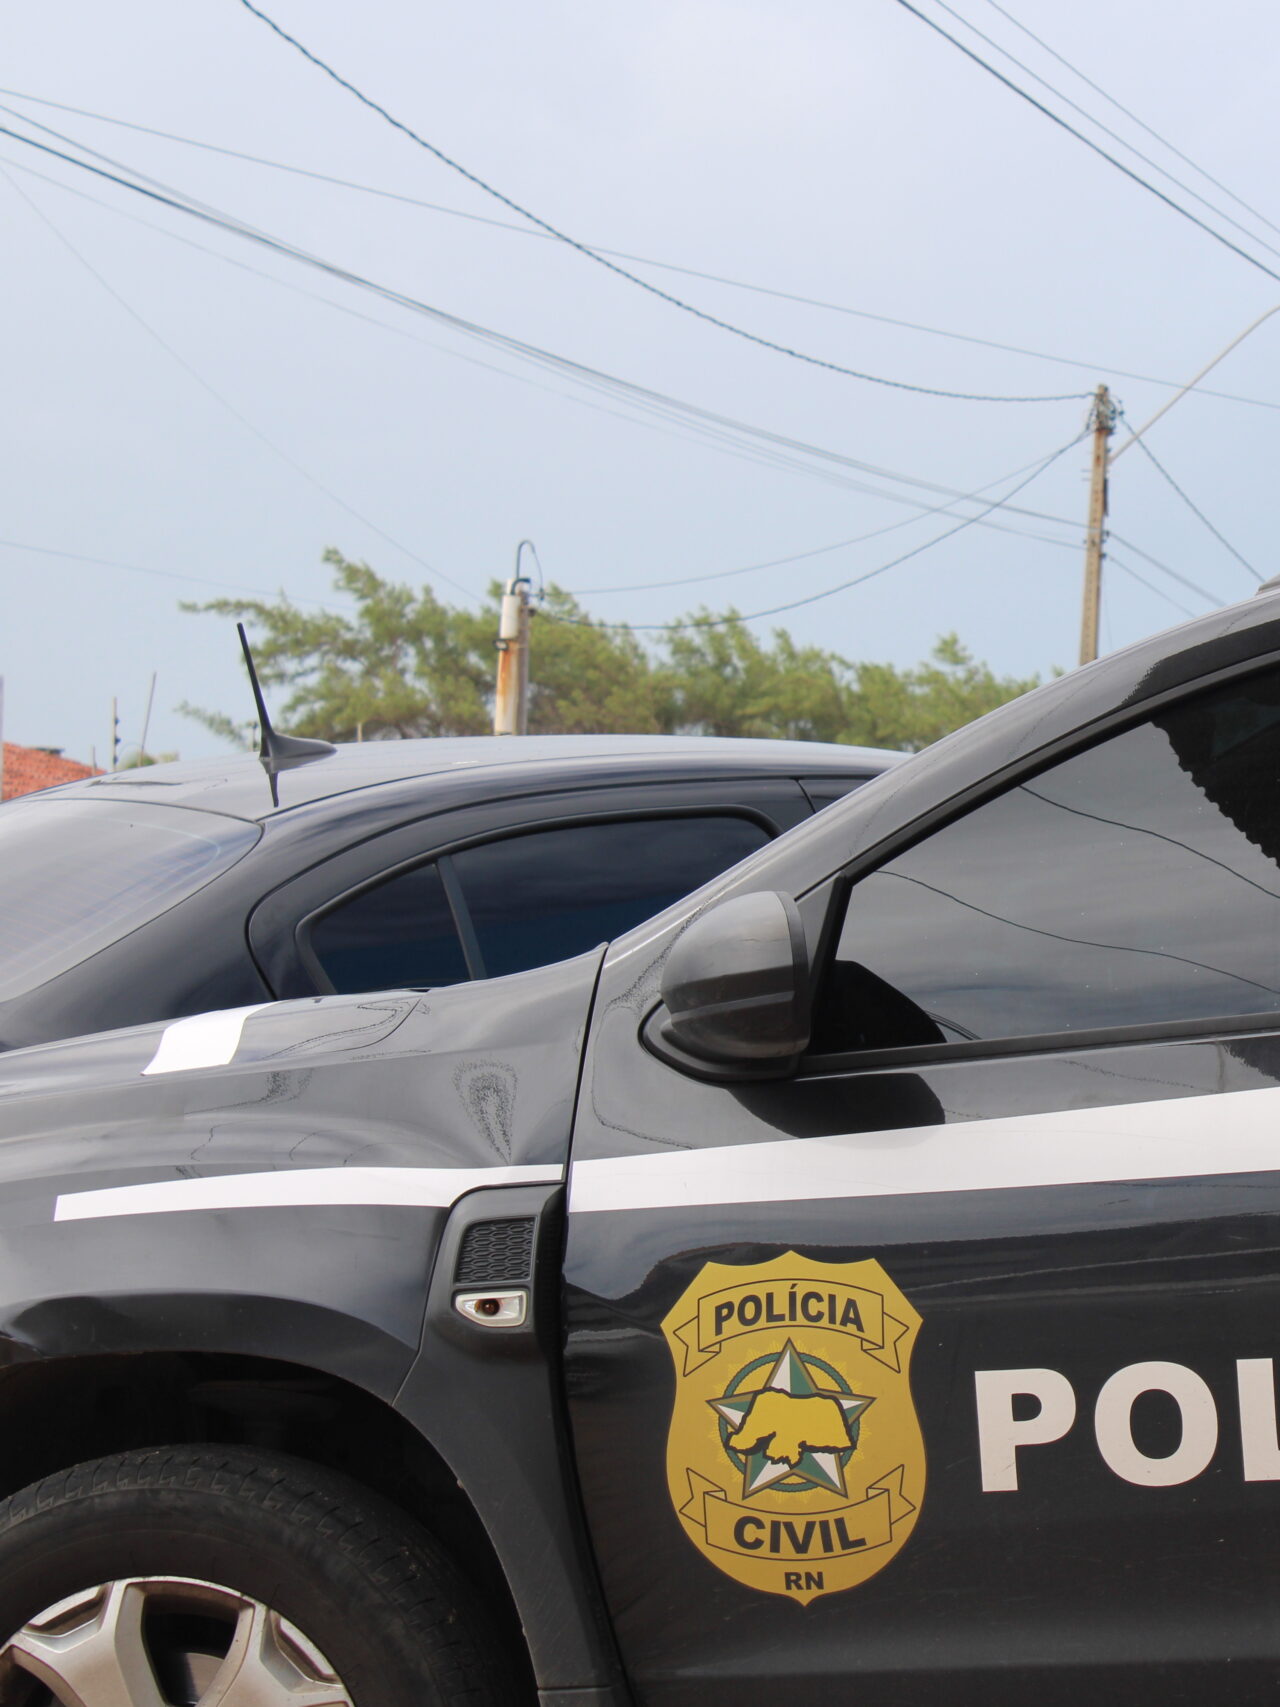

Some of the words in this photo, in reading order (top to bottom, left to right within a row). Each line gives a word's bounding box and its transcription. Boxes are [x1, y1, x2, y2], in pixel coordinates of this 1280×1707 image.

[714, 1283, 865, 1336] POLÍCIA
[733, 1516, 867, 1554] CIVIL
[784, 1571, 825, 1590] RN
